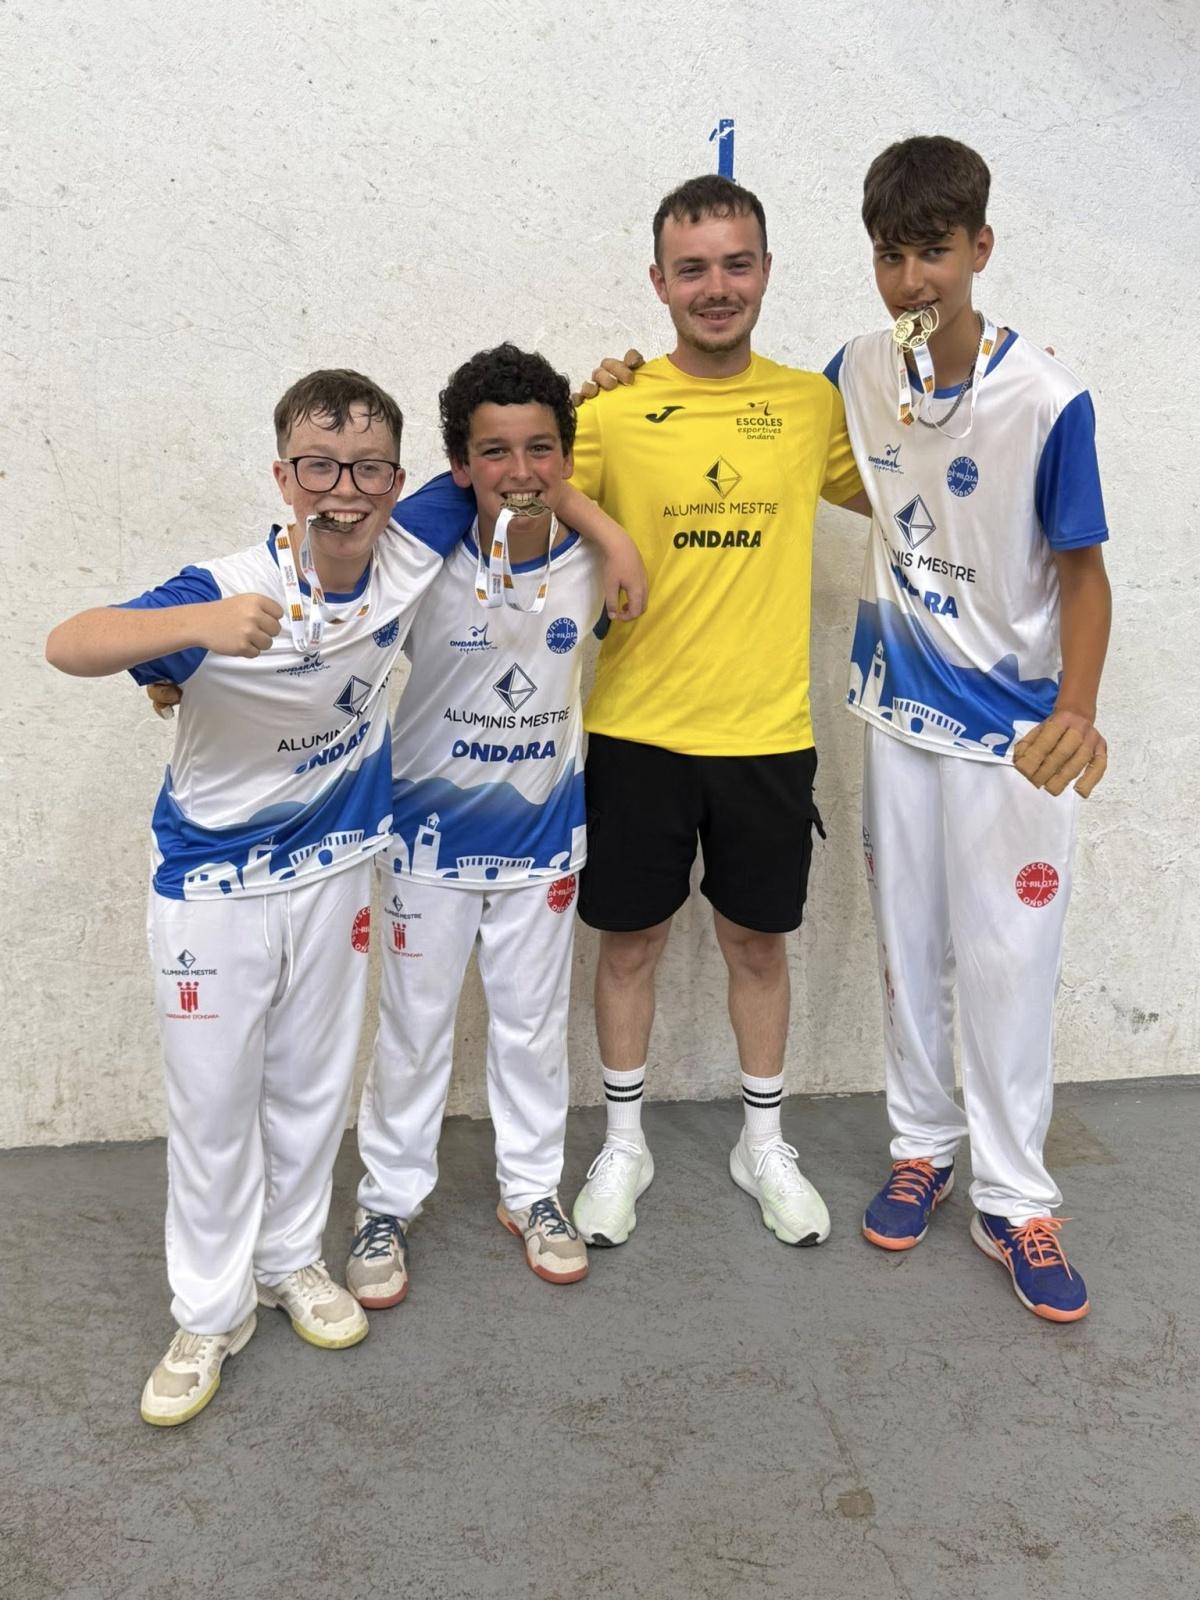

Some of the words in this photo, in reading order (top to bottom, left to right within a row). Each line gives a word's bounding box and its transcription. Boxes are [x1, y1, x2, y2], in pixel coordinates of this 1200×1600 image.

[736, 417, 783, 427] ESCOLES
[737, 426, 782, 435] esportives
[663, 502, 726, 518] ALUMINIS
[729, 502, 779, 515] MESTRE
[673, 529, 762, 549] ONDARA
[918, 553, 976, 583] MESTRE
[443, 707, 516, 728] ALUMINIS
[520, 706, 571, 728] MESTRE
[277, 727, 343, 753] ALUMI
[451, 739, 557, 763] ONDARA
[1021, 863, 1054, 876] ESCOLA
[1029, 880, 1058, 888] PILOTA
[191, 968, 218, 976] MESTRE
